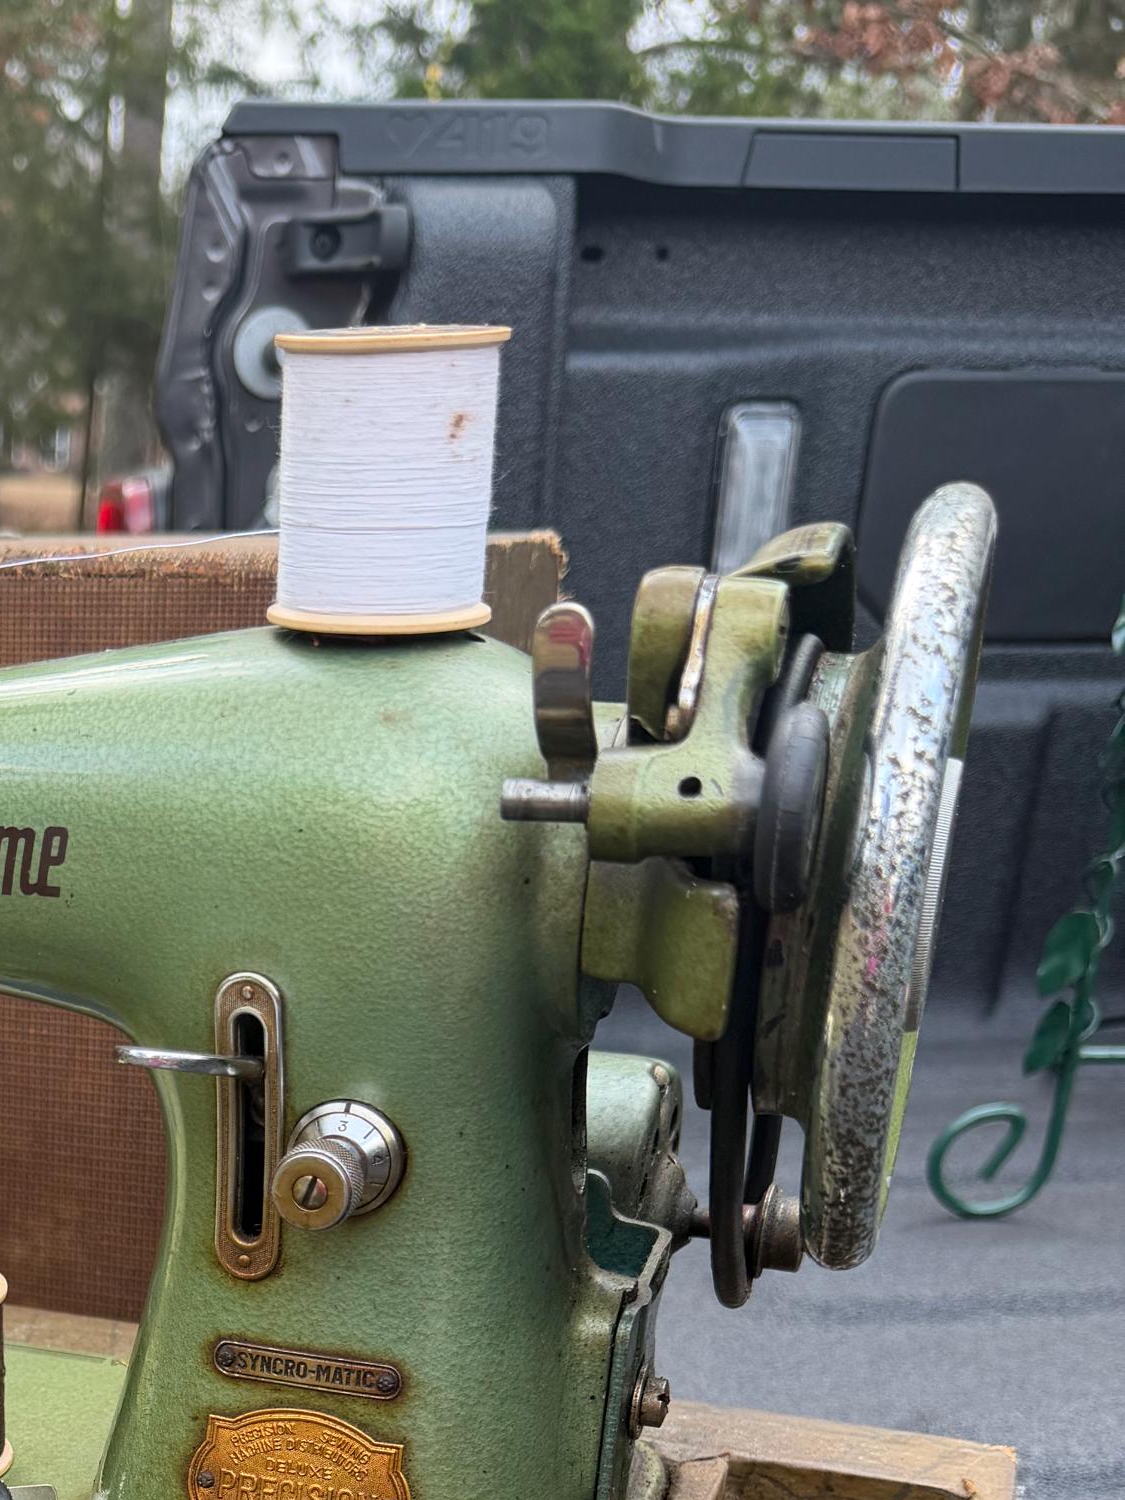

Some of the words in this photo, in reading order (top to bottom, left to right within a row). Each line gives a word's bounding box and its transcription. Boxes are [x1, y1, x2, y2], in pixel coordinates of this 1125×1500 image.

[338, 1120, 349, 1132] 3
[235, 1352, 375, 1389] SYNCRO-MATIC
[230, 1422, 295, 1447] PRECISION
[229, 1438, 282, 1465] MACHINE
[266, 1457, 333, 1481] DELUXE
